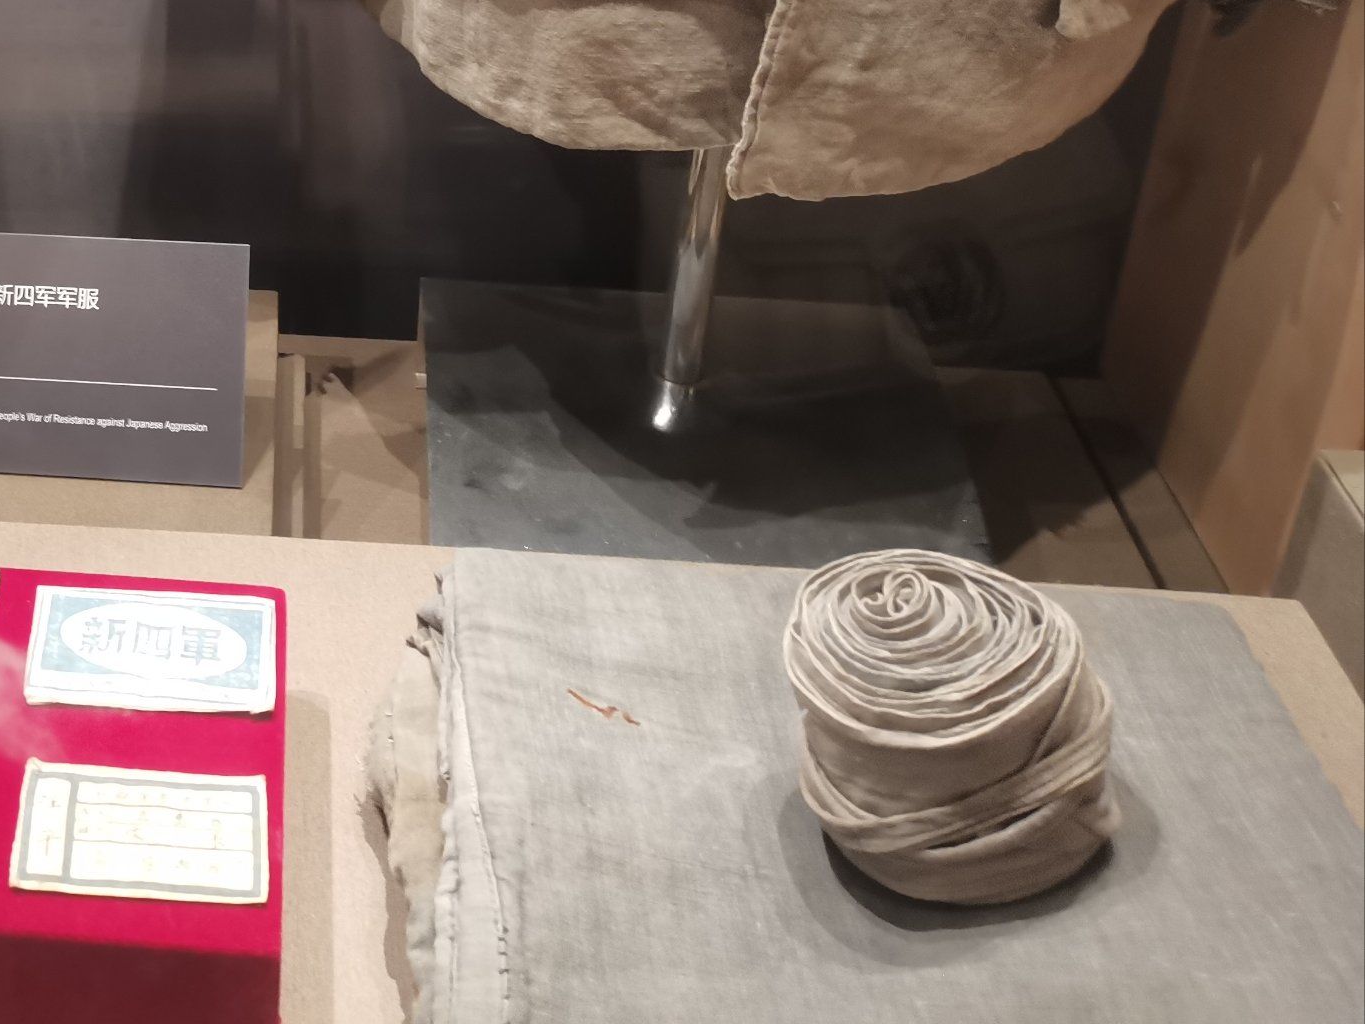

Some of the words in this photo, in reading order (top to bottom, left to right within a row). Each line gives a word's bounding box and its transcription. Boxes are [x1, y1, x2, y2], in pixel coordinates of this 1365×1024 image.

[26, 413, 42, 422] War
[43, 413, 52, 423] of
[53, 414, 95, 425] Resistance
[97, 418, 124, 428] against
[126, 418, 163, 429] Japanese
[164, 421, 208, 432] Aggression
[78, 617, 222, 666] 新四軍
